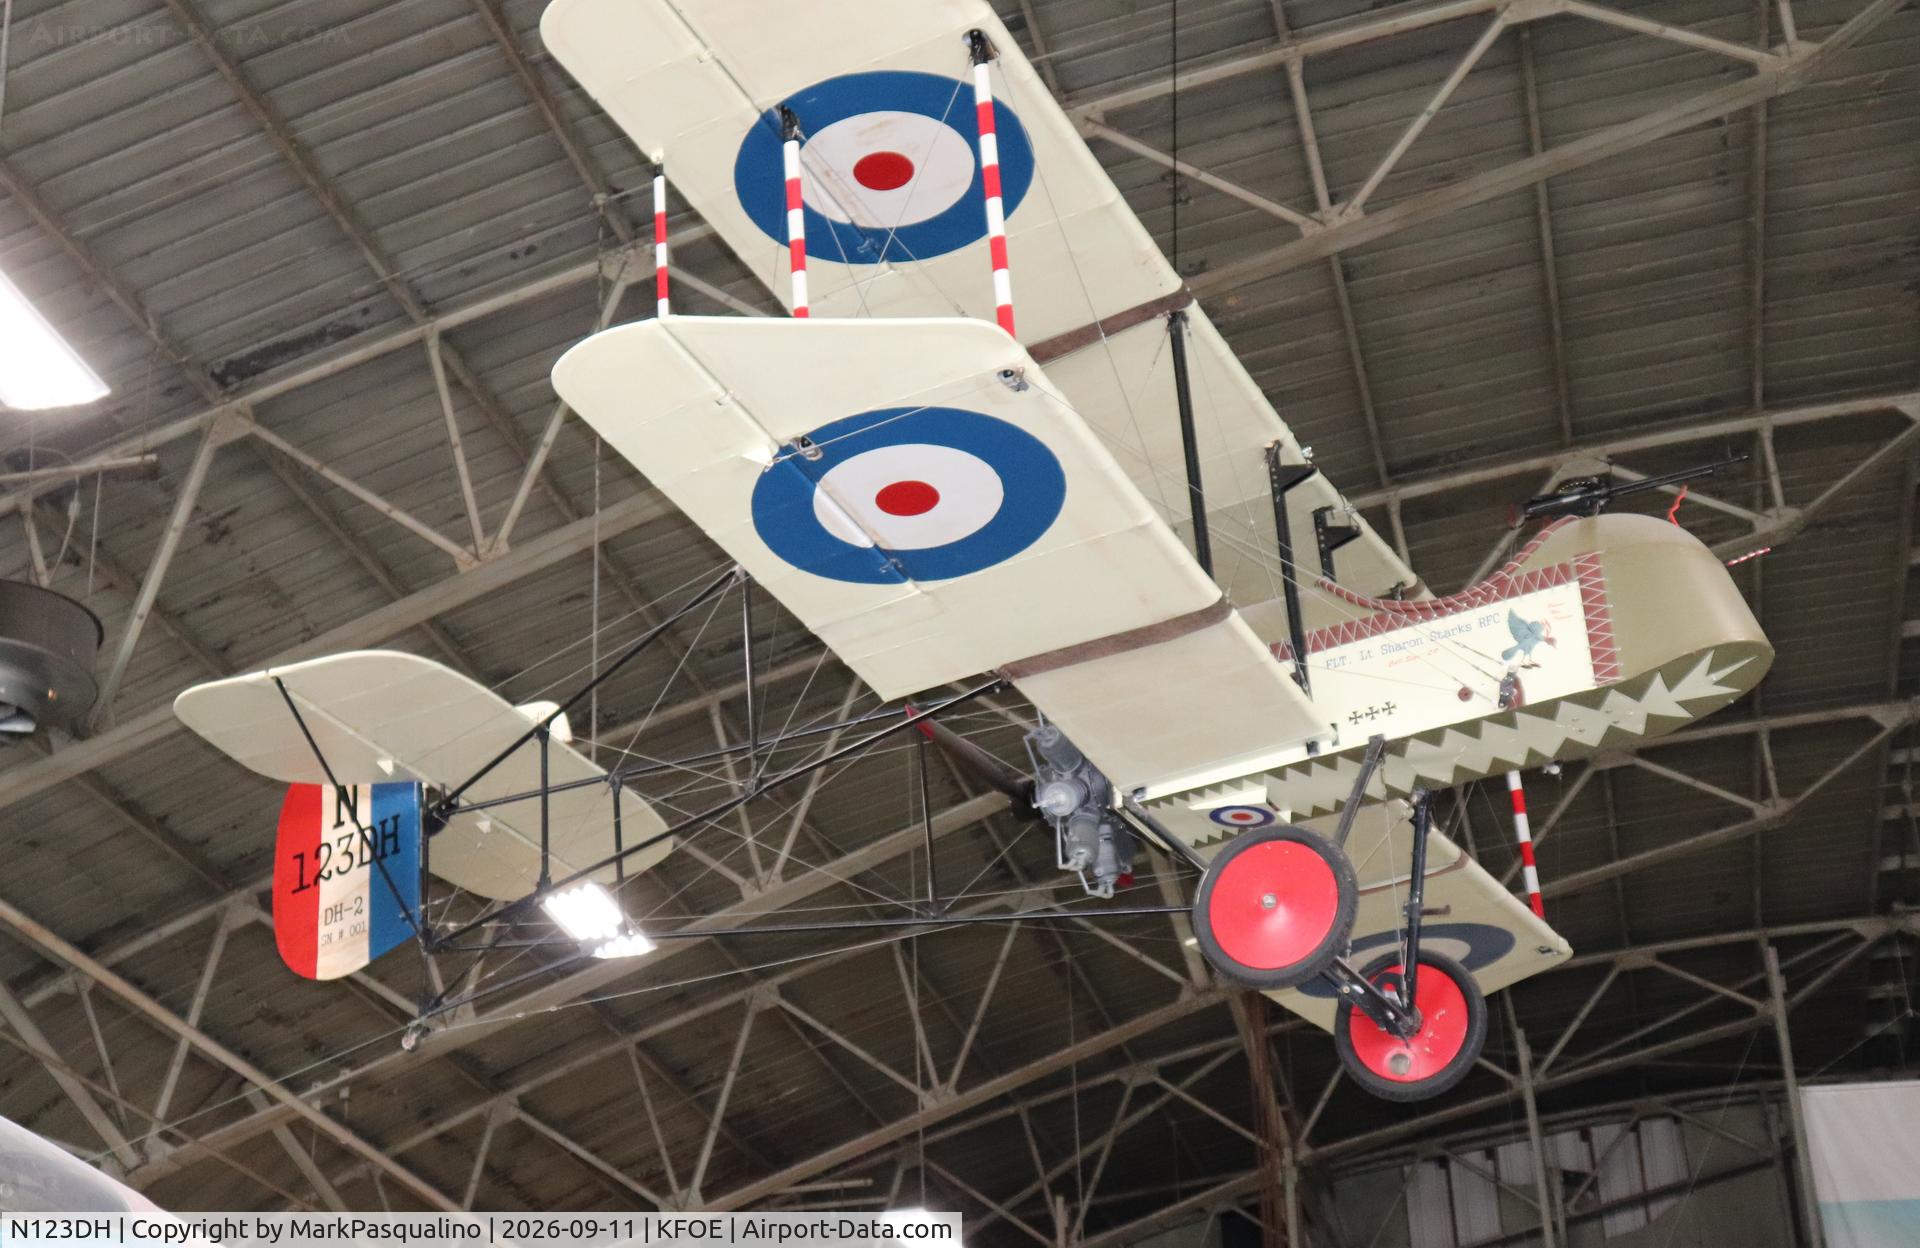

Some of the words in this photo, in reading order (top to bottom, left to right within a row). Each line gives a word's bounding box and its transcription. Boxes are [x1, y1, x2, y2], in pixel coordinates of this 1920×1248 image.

[1359, 649, 1374, 661] Lt
[1380, 637, 1424, 655] Sharon
[1429, 624, 1473, 642] Starks
[1478, 612, 1502, 629] RFC
[332, 783, 358, 830] N
[291, 814, 401, 894] 123DH
[324, 896, 364, 926] DH-2
